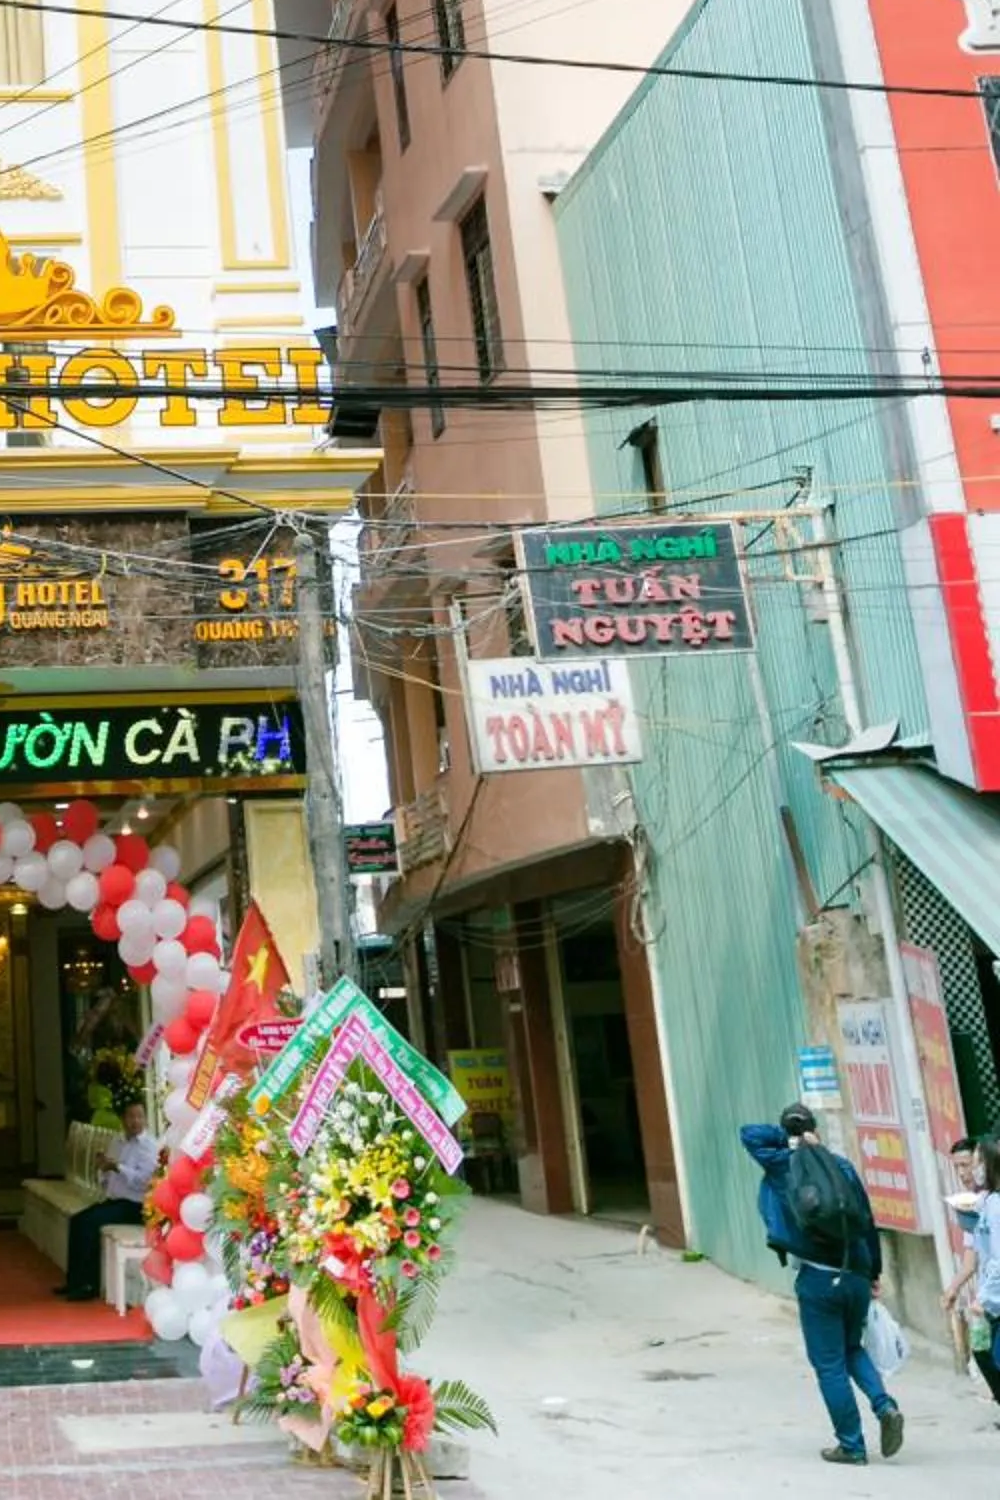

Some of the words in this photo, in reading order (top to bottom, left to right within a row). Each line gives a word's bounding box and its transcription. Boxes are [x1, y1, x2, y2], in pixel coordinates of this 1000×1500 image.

[546, 531, 622, 566] NHÀ
[630, 526, 718, 561] NGHỈ
[17, 579, 105, 606] HOTEL
[218, 557, 297, 613] 317
[572, 564, 701, 607] TUẤN
[195, 619, 264, 642] QUANG
[552, 605, 736, 647] NGUYỆT
[490, 667, 544, 699] NHÀ
[124, 708, 200, 765] CÀ
[486, 702, 576, 764] TOÀN
